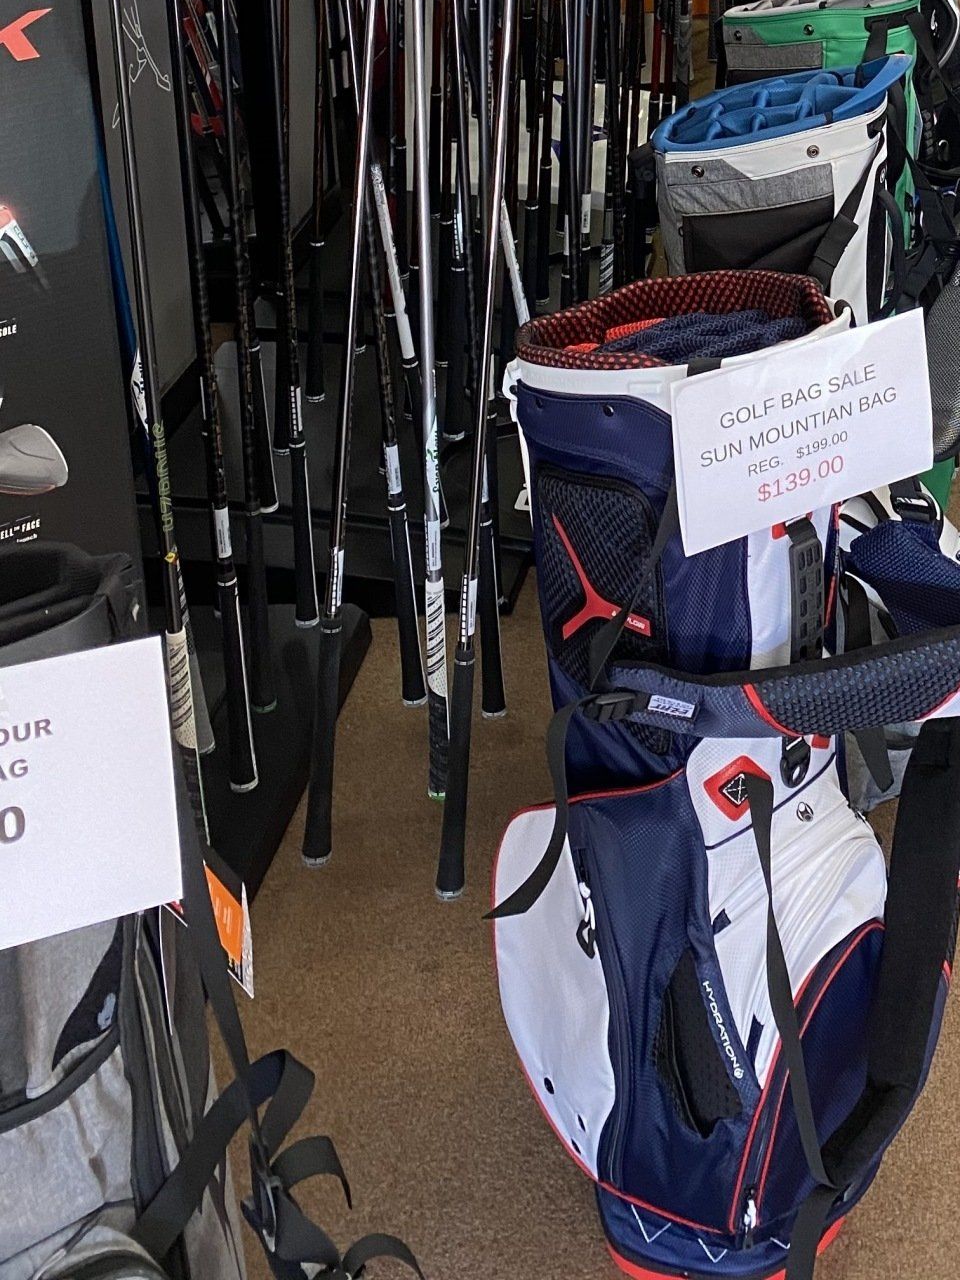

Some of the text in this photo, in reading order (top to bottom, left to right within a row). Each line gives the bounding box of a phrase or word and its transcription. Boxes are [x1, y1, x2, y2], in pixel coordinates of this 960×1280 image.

[720, 364, 877, 429] GOLF BAG SALE
[701, 387, 897, 468] SUN MOUNTIAN BAG
[747, 431, 848, 477] REG. $199.00
[757, 455, 845, 502] $139.00
[21, 519, 41, 534] FACE
[702, 981, 740, 1068] HYDRATION
